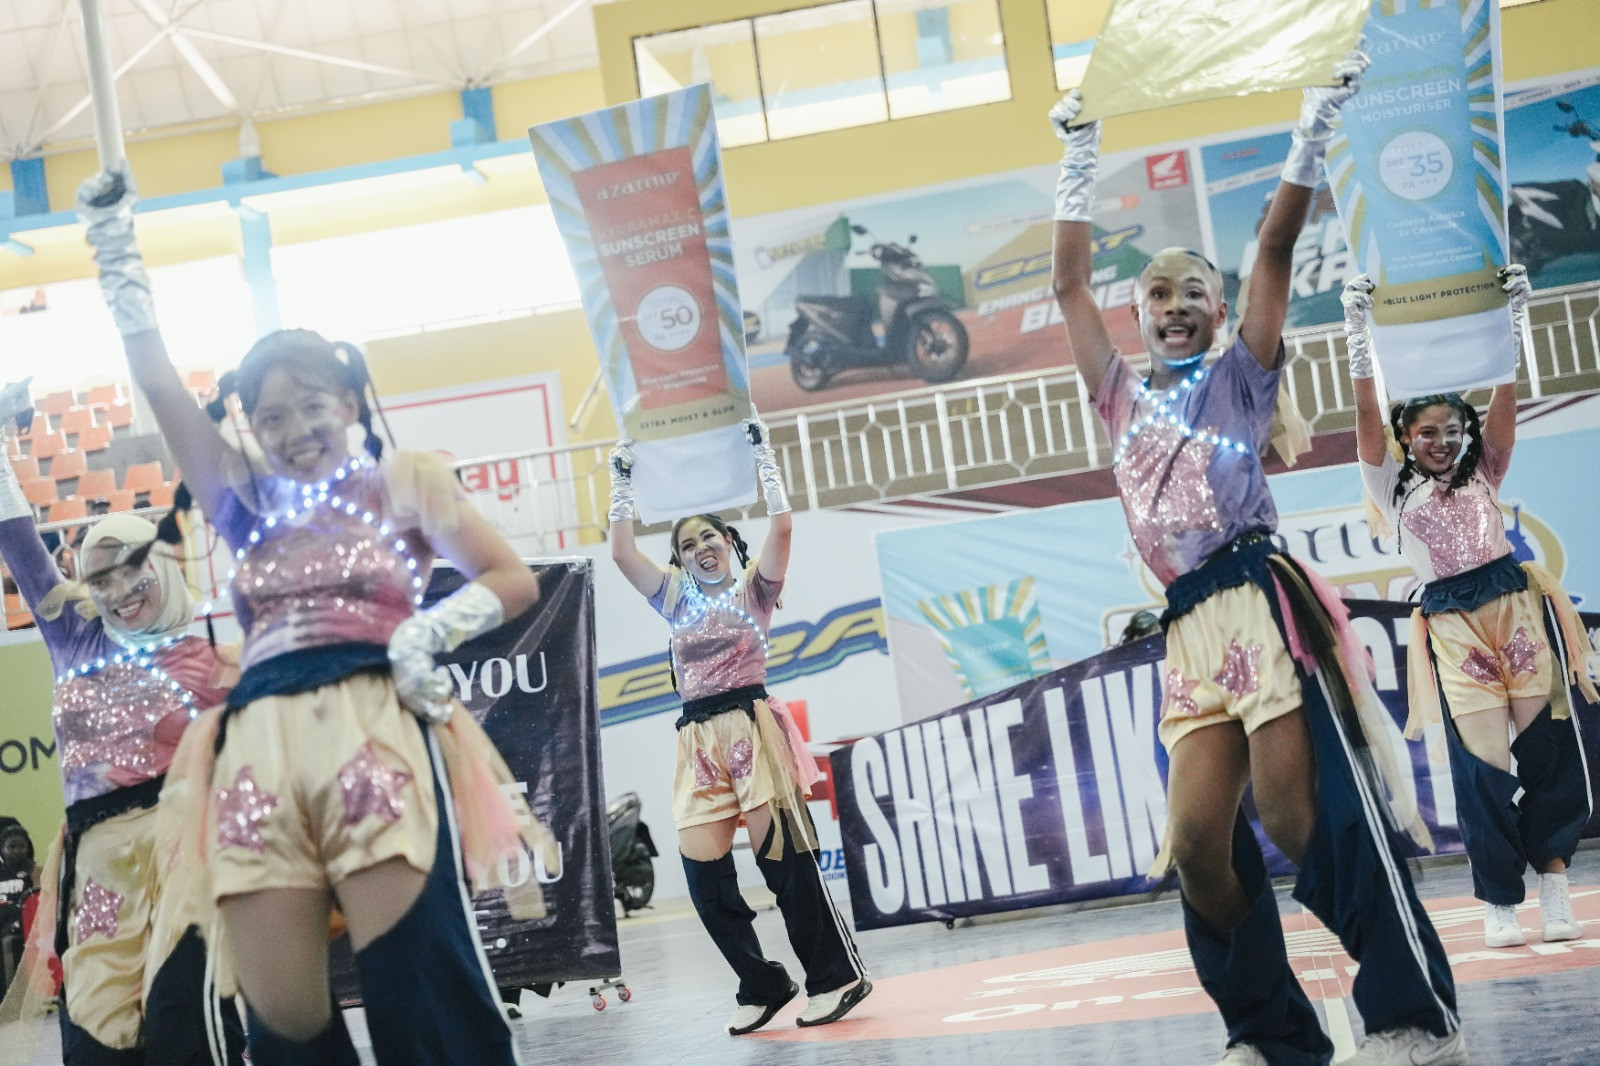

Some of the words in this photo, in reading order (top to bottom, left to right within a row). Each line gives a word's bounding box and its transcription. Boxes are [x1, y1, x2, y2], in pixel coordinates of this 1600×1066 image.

[1344, 78, 1461, 112] SUNSCREEN
[1361, 98, 1452, 124] MOISTURISER
[1407, 150, 1445, 178] 35
[1402, 180, 1417, 190] PA
[600, 222, 700, 257] SUNSCREEN
[624, 243, 685, 269] SERUM
[1410, 292, 1437, 303] LIGHT
[1440, 282, 1495, 298] PROTECTION
[660, 305, 694, 330] 50
[640, 418, 668, 430] EXTRA
[670, 412, 699, 424] MOIST
[449, 651, 548, 701] YOU
[850, 697, 1051, 915] SHINE
[1042, 656, 1168, 886] LIK
